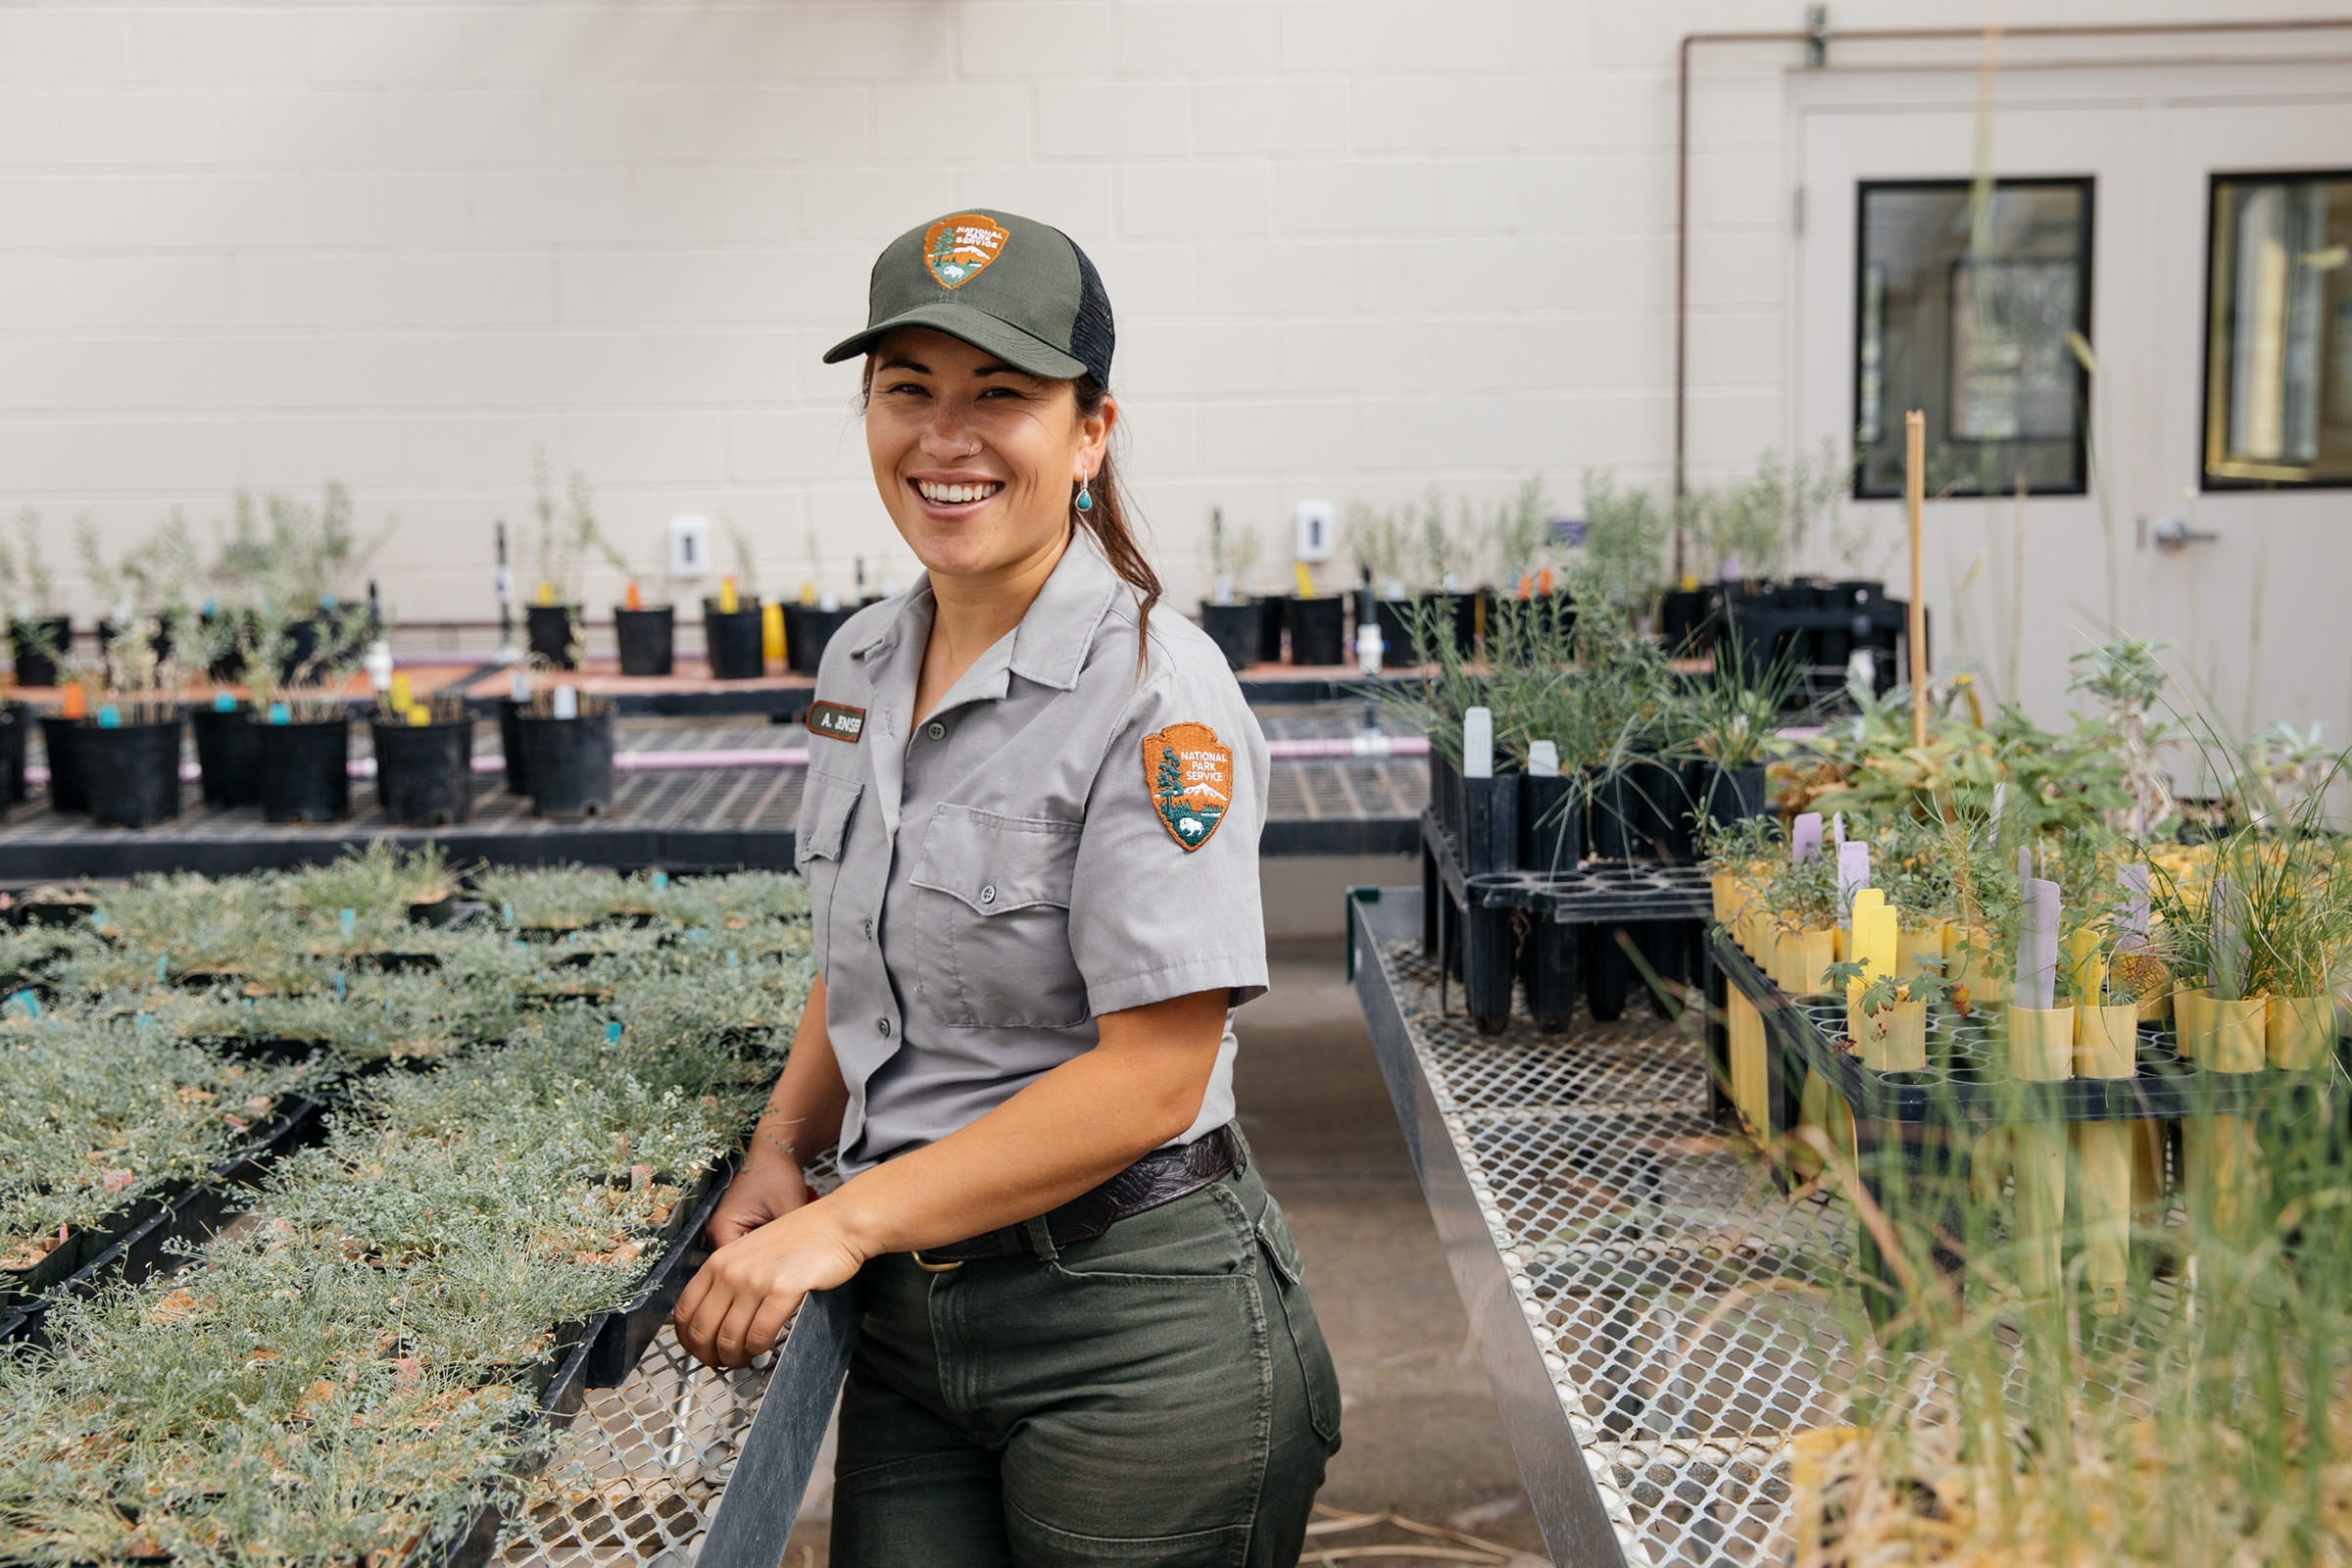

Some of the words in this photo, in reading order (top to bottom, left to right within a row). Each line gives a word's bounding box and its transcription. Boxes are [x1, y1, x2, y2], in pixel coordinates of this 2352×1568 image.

[956, 226, 1003, 239] NATIONAL
[956, 236, 998, 249] SERVICE
[820, 711, 832, 727] A.
[1181, 751, 1227, 762] NATIONAL
[1192, 761, 1216, 771] PARK
[1186, 771, 1223, 782] SERVICE
